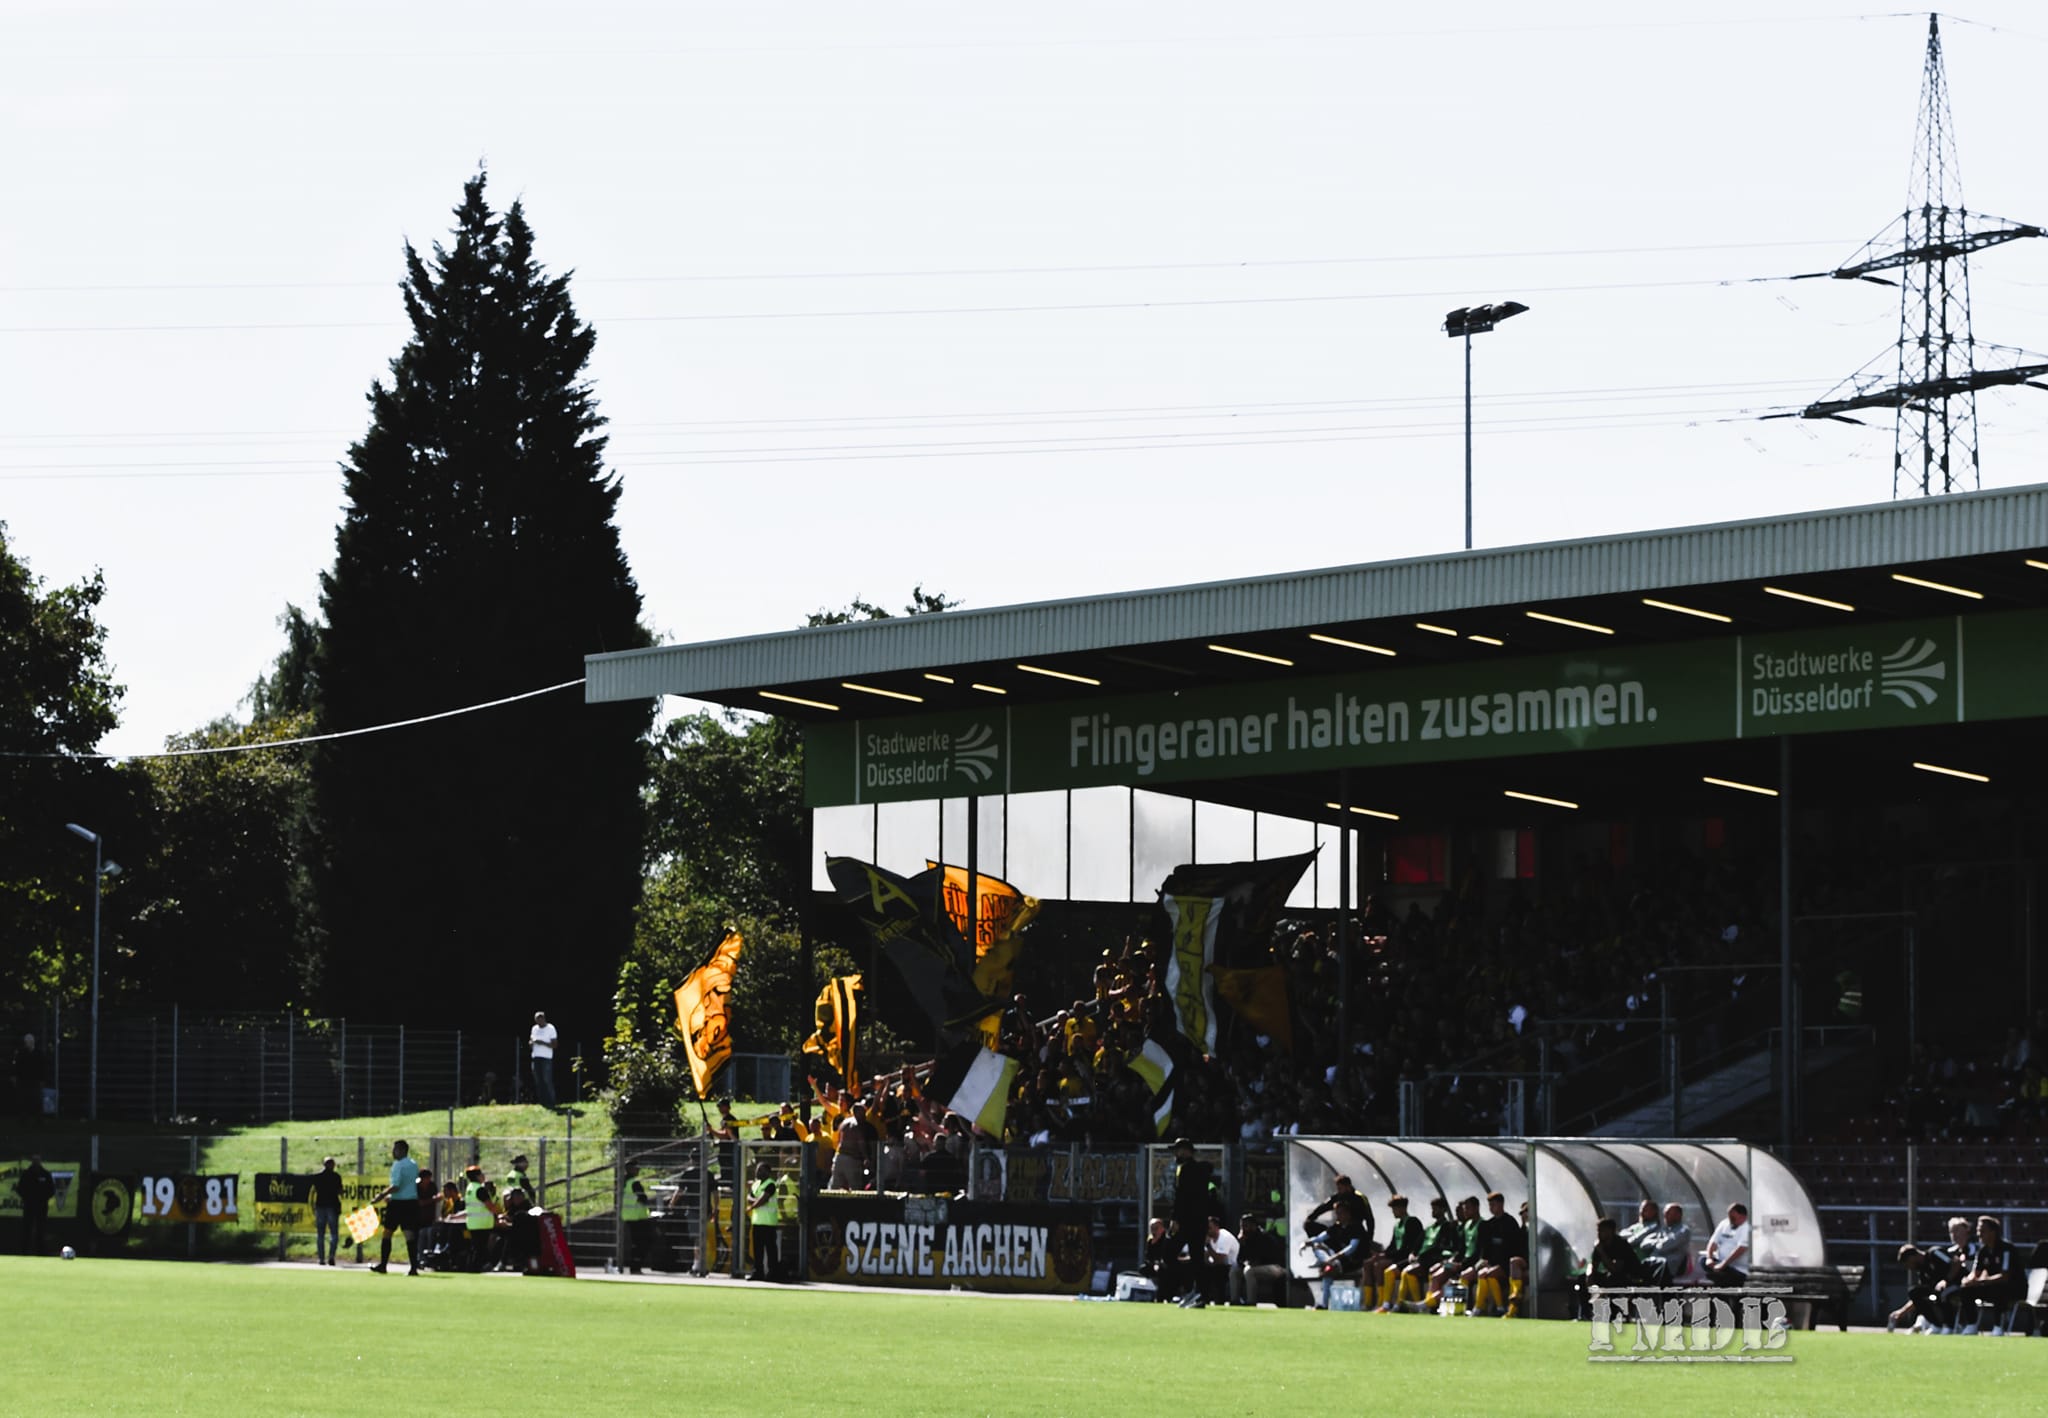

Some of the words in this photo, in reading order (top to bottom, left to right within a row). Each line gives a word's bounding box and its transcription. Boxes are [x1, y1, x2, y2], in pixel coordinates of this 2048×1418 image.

[1753, 646, 1873, 680] Stadtwerke
[1753, 679, 1873, 716] Düsseldorf
[867, 728, 950, 757] Stadtwerke
[1070, 712, 1279, 776] Flingeraner
[1287, 692, 1409, 750] halten
[1420, 681, 1658, 741] zusammen.
[867, 757, 950, 787] Düsseldorf
[142, 1176, 175, 1216] 19
[206, 1178, 238, 1216] 81
[845, 1220, 935, 1276] SZENE
[941, 1223, 1049, 1278] AACHEN
